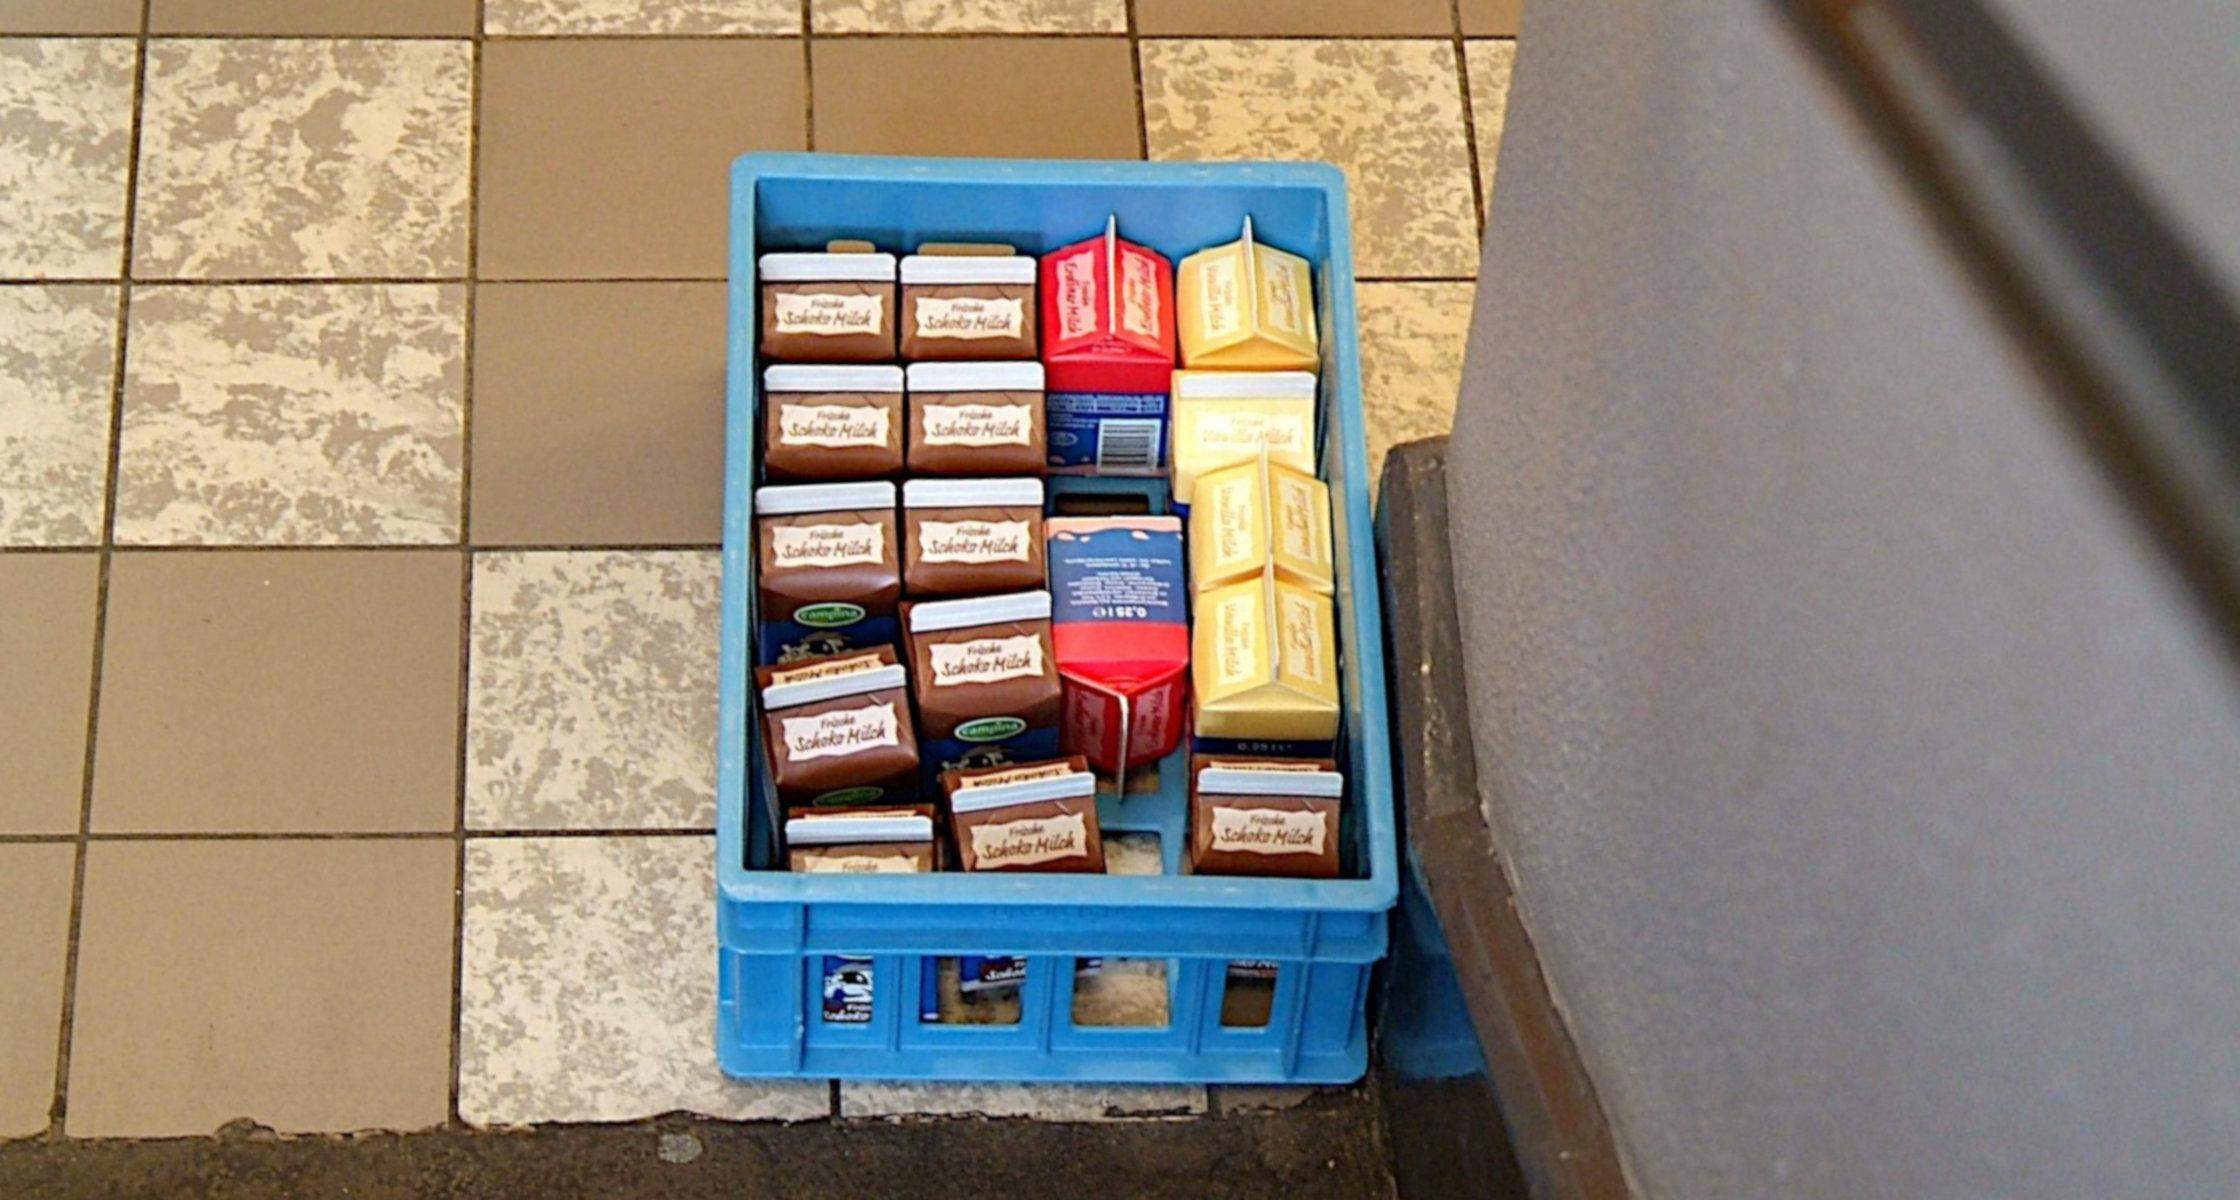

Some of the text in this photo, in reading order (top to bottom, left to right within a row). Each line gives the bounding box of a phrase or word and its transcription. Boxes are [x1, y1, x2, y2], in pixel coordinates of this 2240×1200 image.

[784, 309, 871, 327] Schoko Milch
[925, 312, 1012, 330] Schoko Milch
[789, 420, 877, 438] Schoko Milch
[931, 420, 1020, 438] Schoko Milch
[783, 540, 872, 559] Schoko Milch
[929, 538, 1018, 555] Schoko Milch
[942, 654, 1032, 677] Schoko Milch
[795, 722, 886, 753] Schoko Milch
[982, 830, 1075, 859] Schoko Milch
[1222, 826, 1313, 846] Schoko Milch
